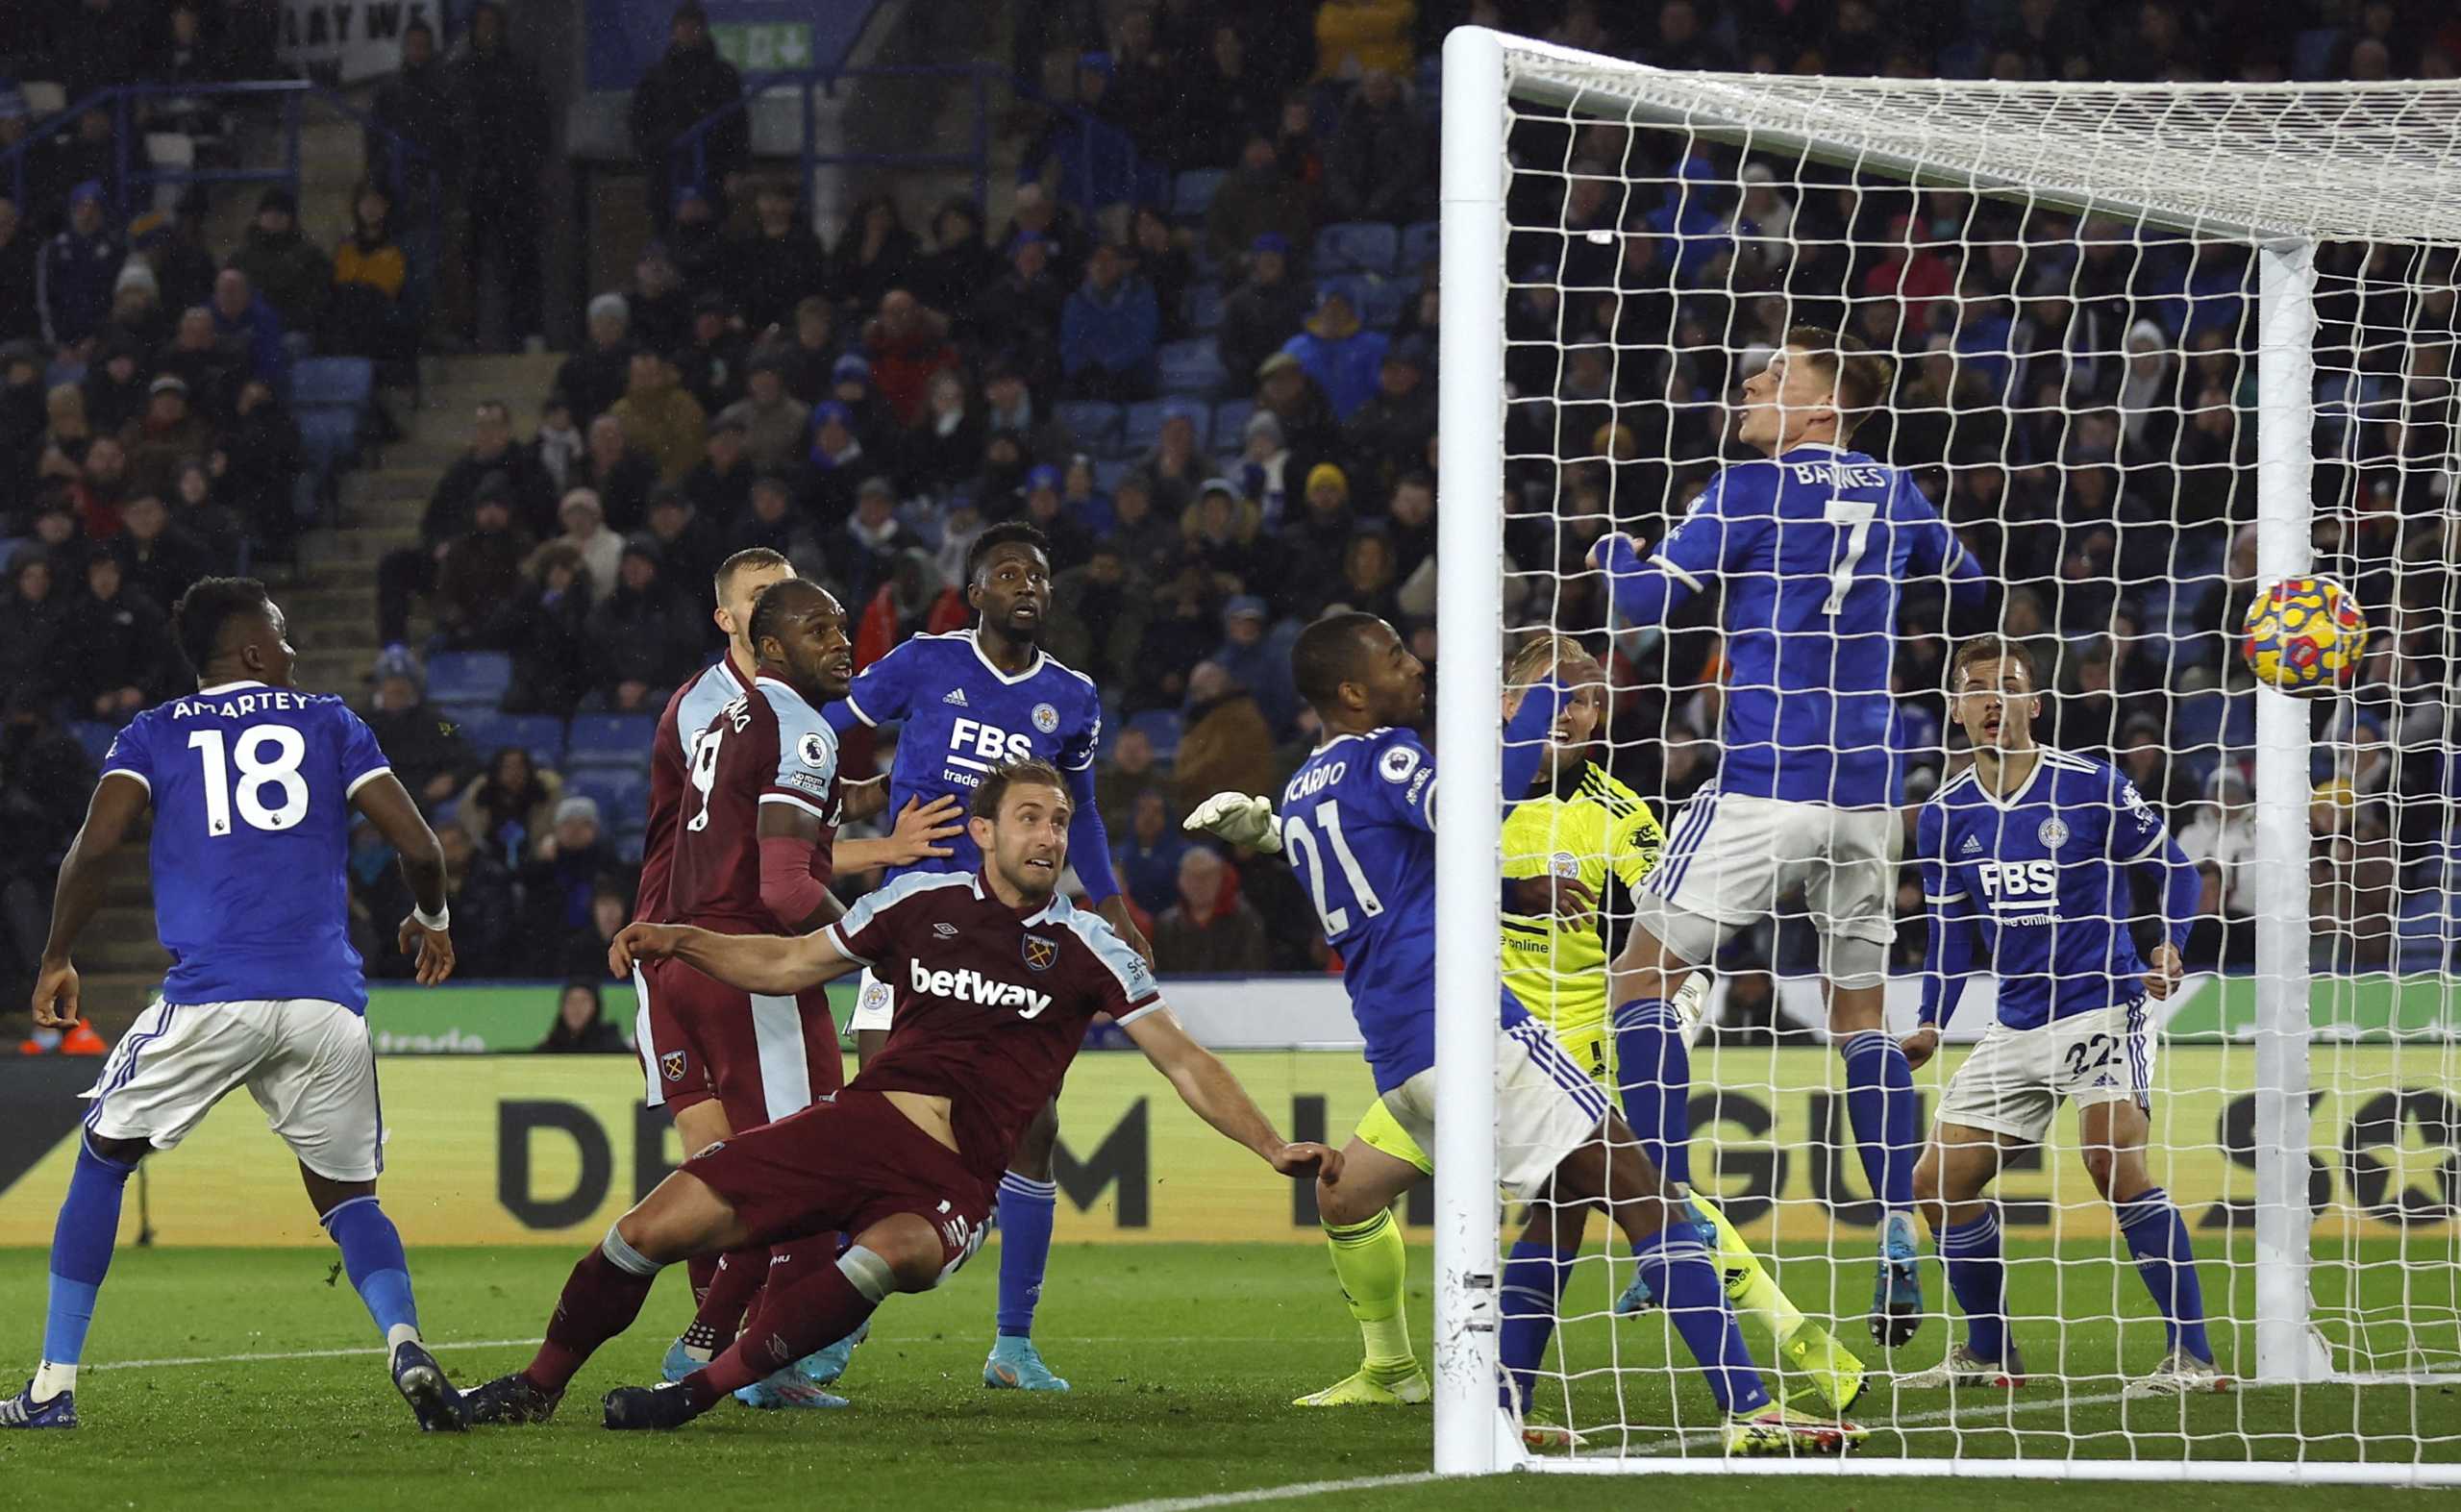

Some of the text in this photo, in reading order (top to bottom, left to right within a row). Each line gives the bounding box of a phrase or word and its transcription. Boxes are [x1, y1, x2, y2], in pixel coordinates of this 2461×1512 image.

[1821, 500, 1877, 615] 7
[173, 692, 308, 719] AMARTEY
[949, 717, 1032, 765] FBS
[187, 724, 310, 837] 18
[686, 728, 724, 831] 9
[943, 768, 980, 788] trade
[1281, 761, 1346, 806] ICARDO
[1284, 800, 1384, 937] 21
[1978, 862, 2055, 896] FBS
[1509, 937, 1549, 954] online
[910, 957, 1053, 1020] betway
[2064, 1033, 2124, 1081] 22
